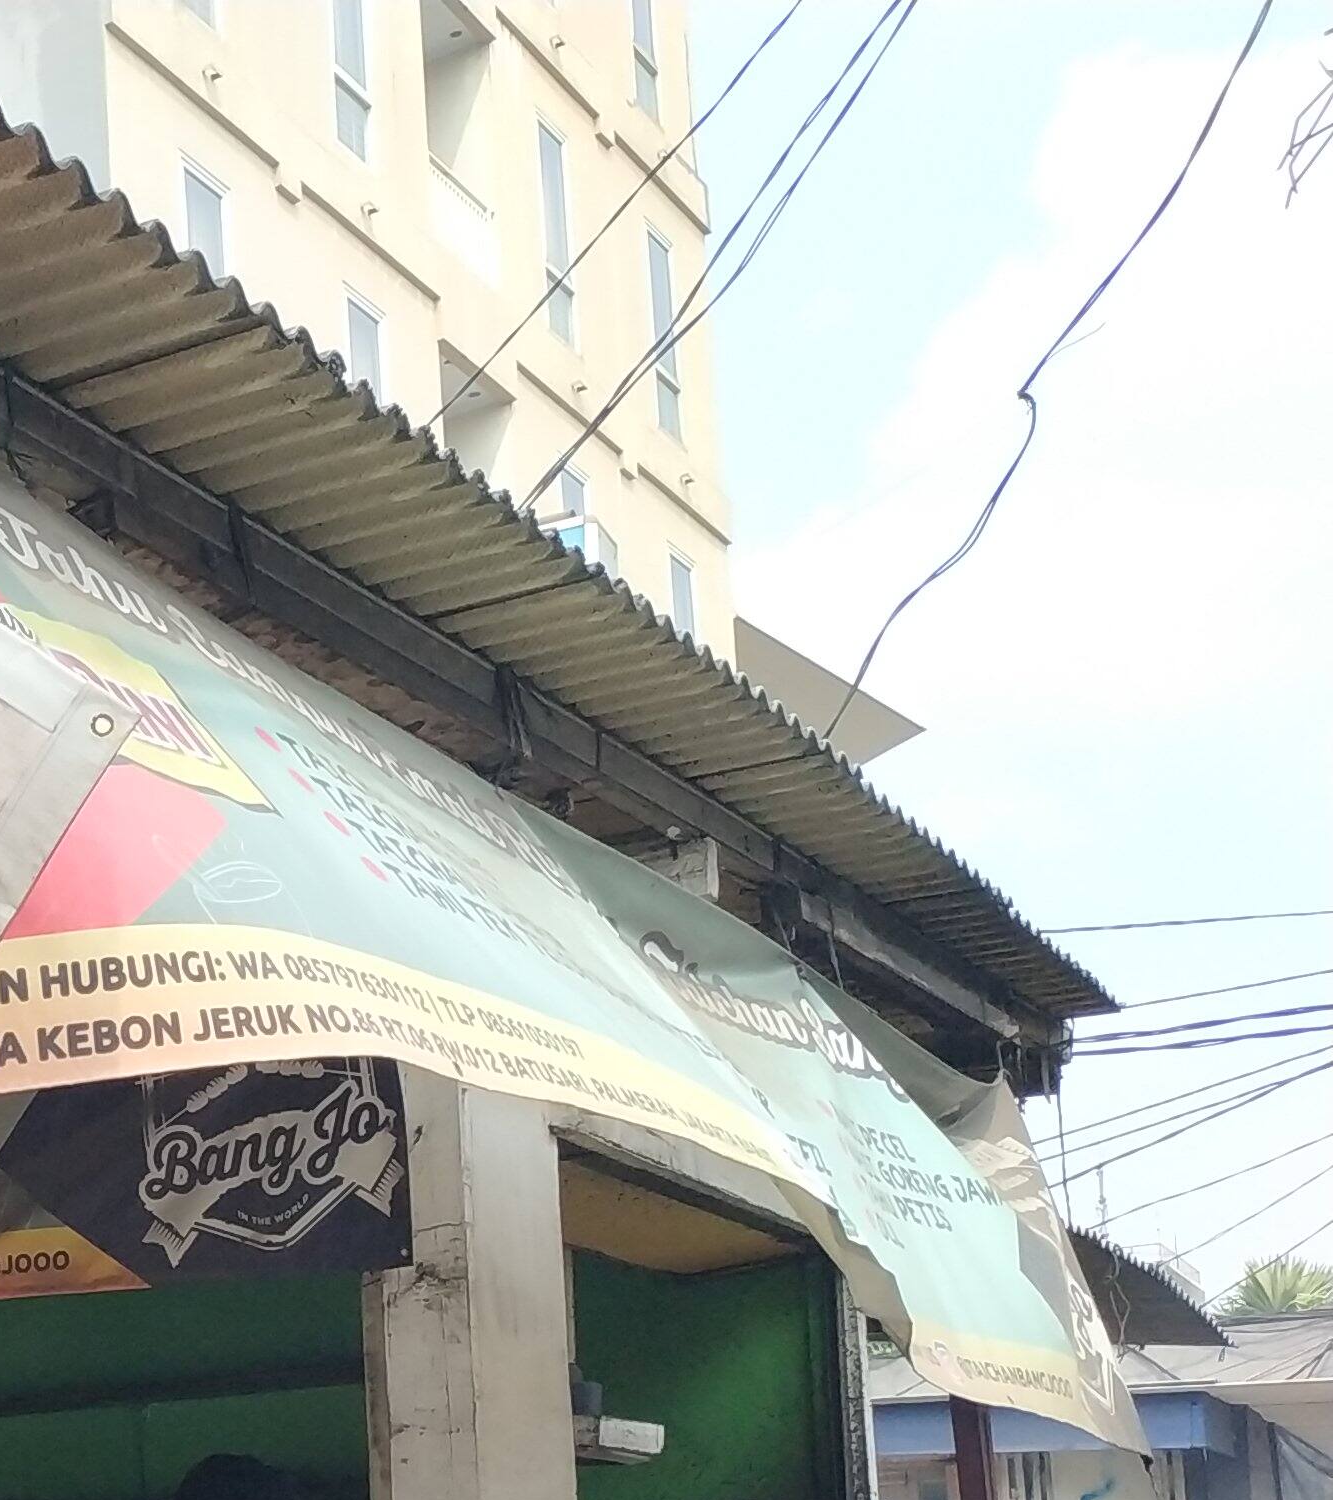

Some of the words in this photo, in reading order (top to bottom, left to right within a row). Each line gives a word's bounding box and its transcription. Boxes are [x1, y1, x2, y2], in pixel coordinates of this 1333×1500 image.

[39, 950, 227, 1001] HUBUNGI:
[227, 950, 284, 981] WA
[282, 952, 431, 1014] 085797630112
[437, 995, 475, 1027] TLP
[36, 1010, 183, 1063] KEBON
[192, 1003, 303, 1043] JERUK
[144, 1122, 307, 1201] Bang
[306, 1085, 393, 1179] Jo
[236, 1208, 250, 1223] IN
[251, 1214, 272, 1226] THE
[274, 1192, 311, 1225] WORLD
